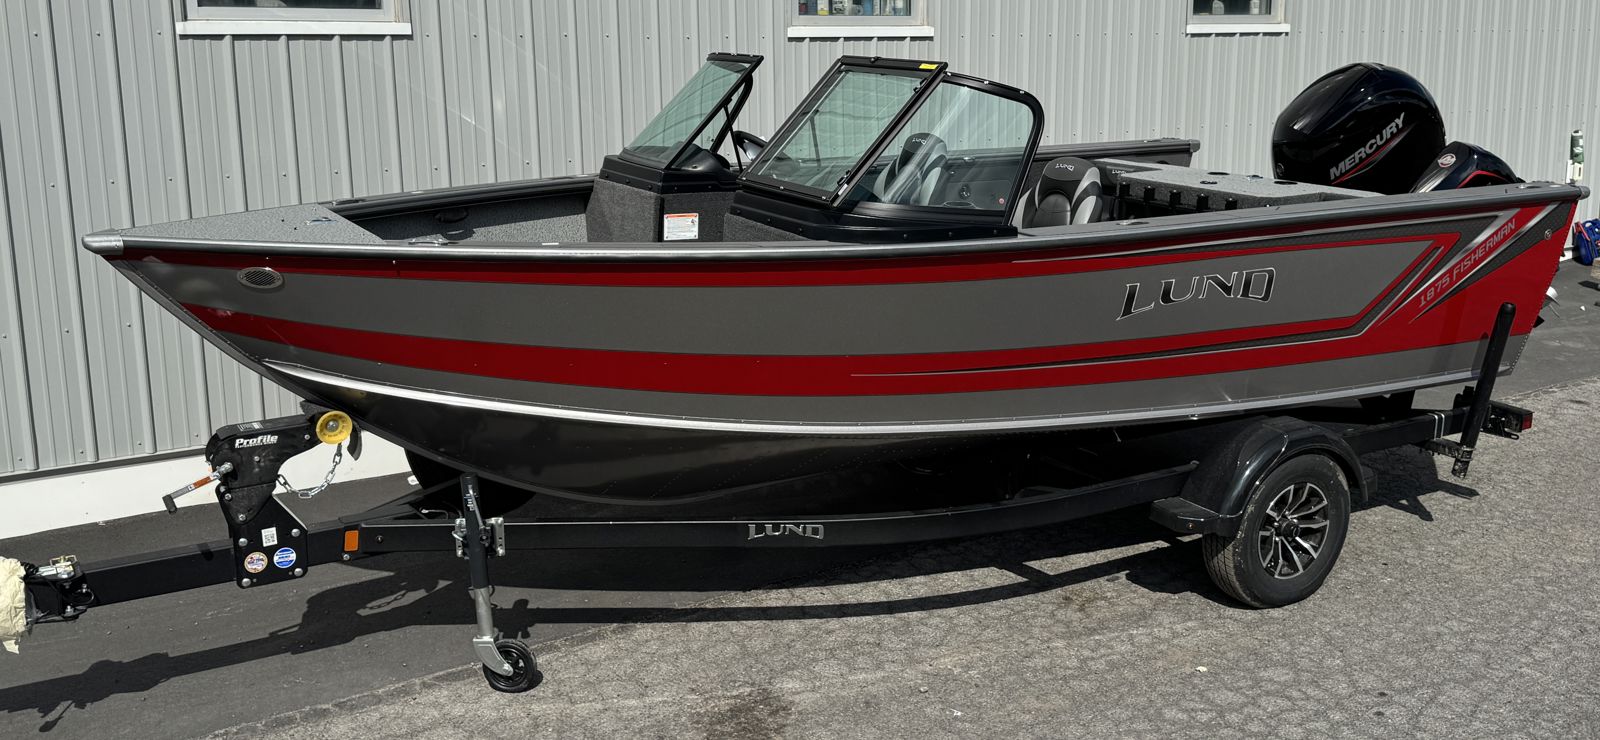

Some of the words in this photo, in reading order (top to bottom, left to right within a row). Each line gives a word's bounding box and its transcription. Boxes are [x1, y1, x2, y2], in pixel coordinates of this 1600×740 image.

[1329, 112, 1406, 181] MERCURY
[1418, 273, 1451, 308] 1875
[1452, 218, 1516, 282] FISHERMAN
[1115, 267, 1276, 321] LUND
[235, 434, 279, 446] Profile
[747, 524, 824, 541] LUND
